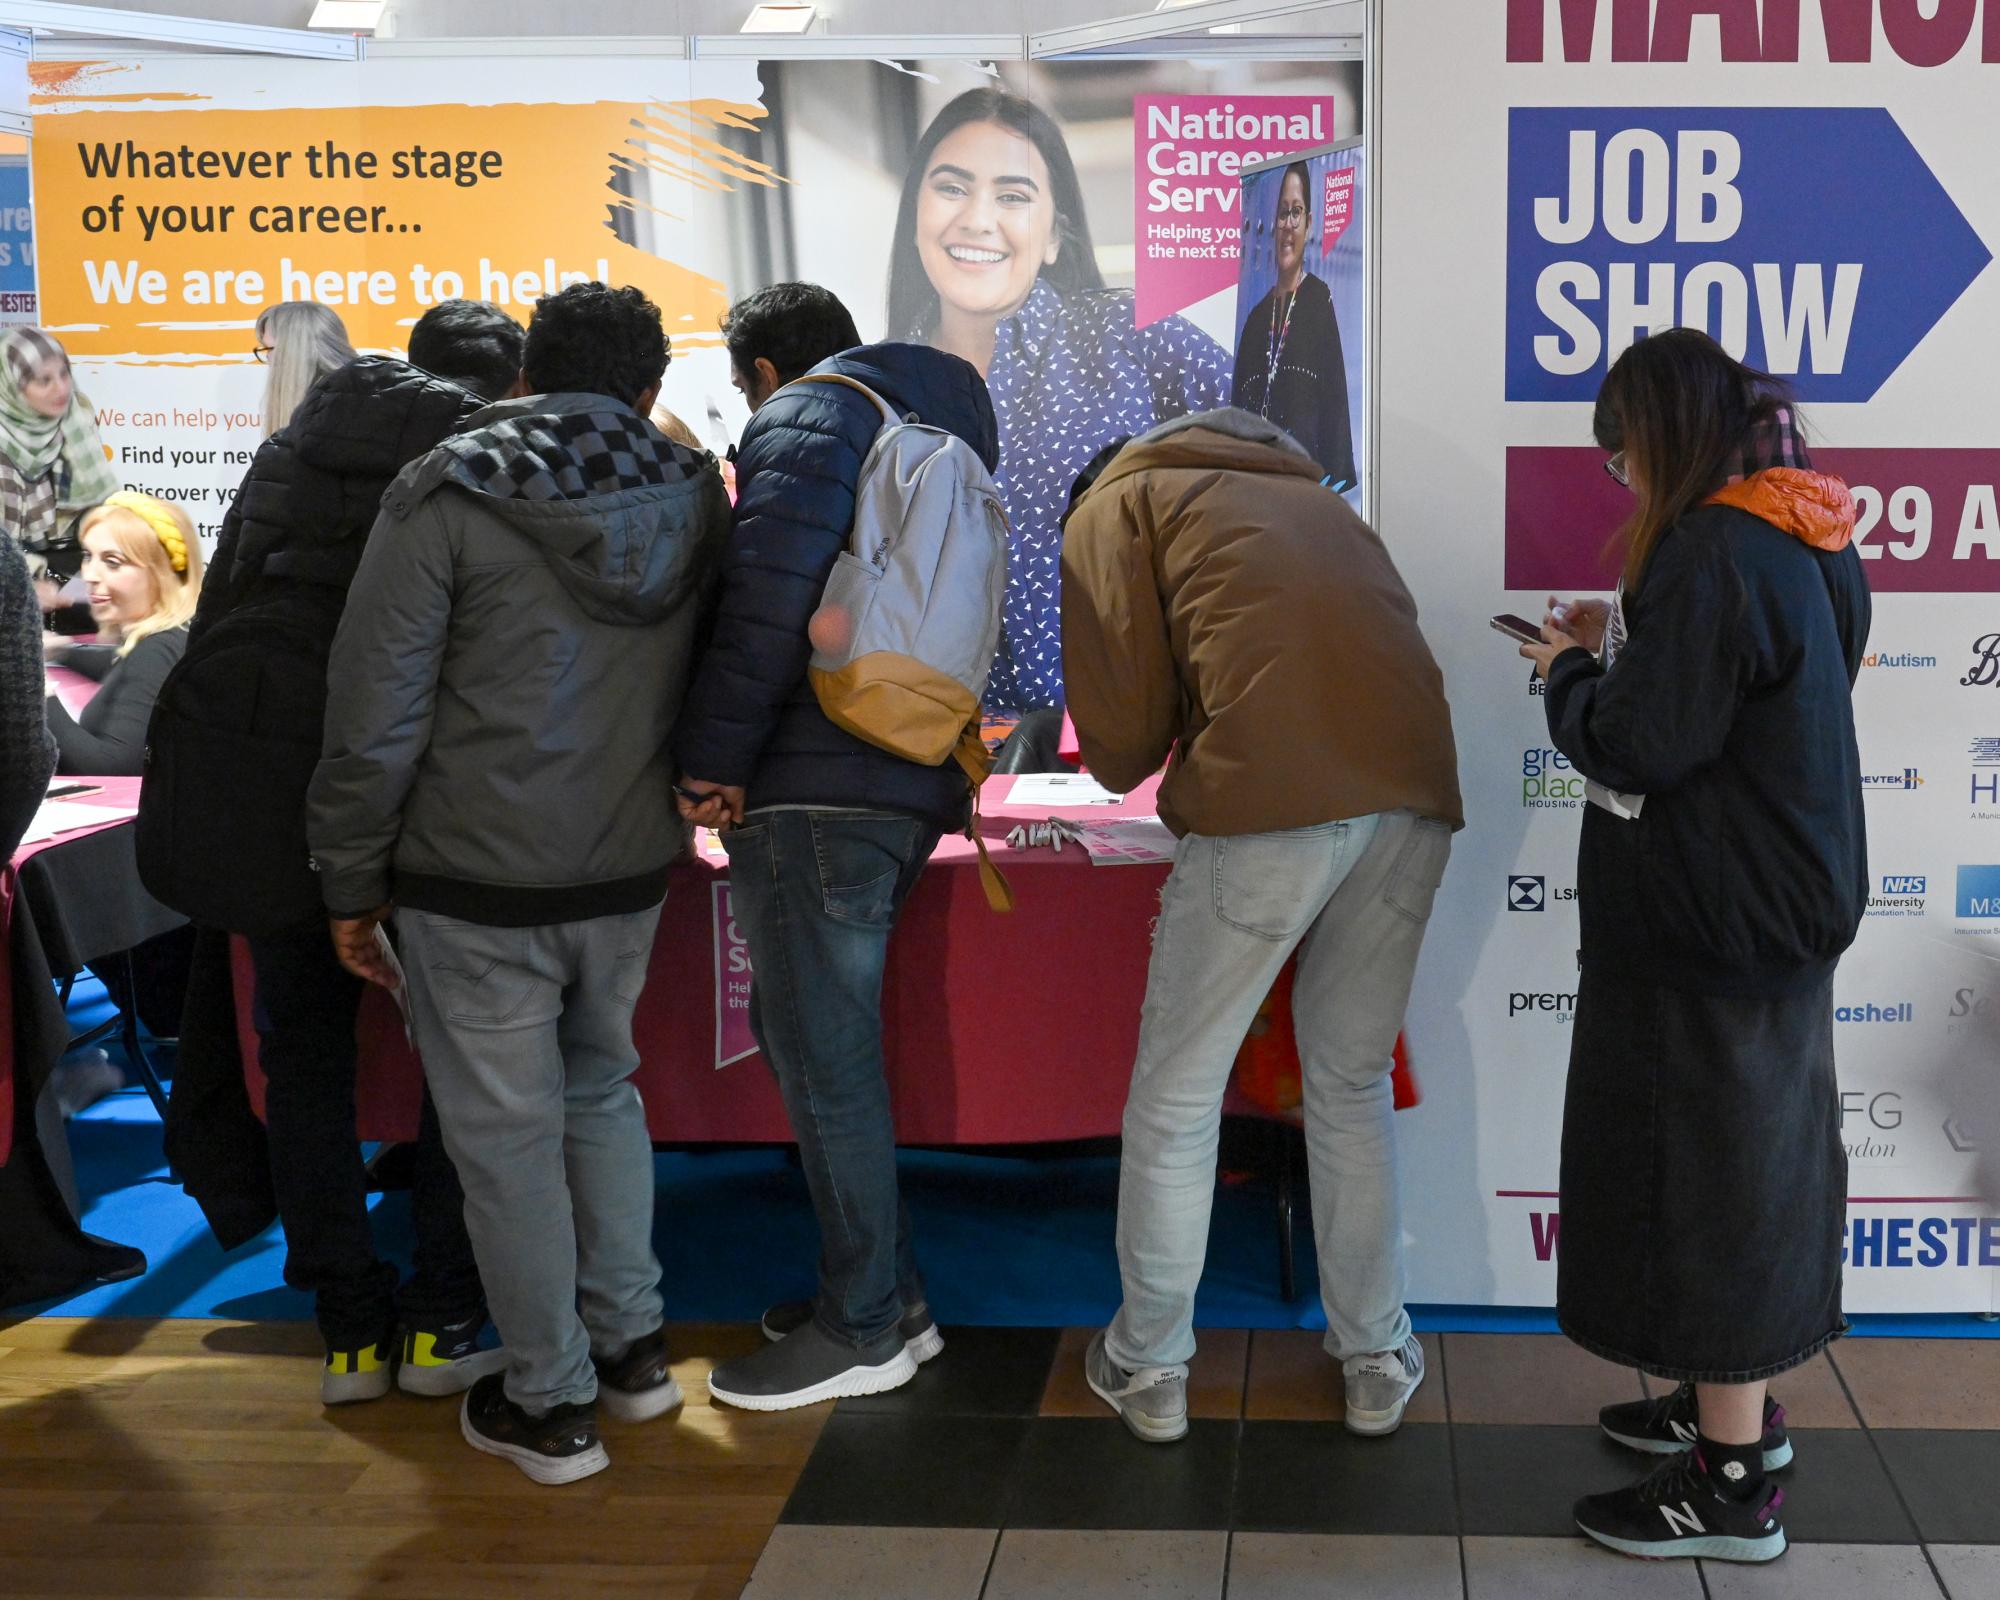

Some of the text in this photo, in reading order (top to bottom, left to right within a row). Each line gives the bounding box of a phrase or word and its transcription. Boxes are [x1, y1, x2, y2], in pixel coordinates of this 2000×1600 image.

[1147, 104, 1325, 140] National
[78, 140, 503, 188] Whatever the stage
[1147, 142, 1297, 176] Caree
[1147, 179, 1241, 213] Serv
[1534, 128, 1743, 245] JOB
[82, 195, 422, 241] of your career...
[1147, 224, 1212, 242] Helping
[1147, 243, 1175, 258] the
[1180, 244, 1216, 258] next
[83, 259, 167, 304] We
[183, 269, 264, 304] are
[280, 258, 397, 304] here
[410, 264, 463, 304] to
[1533, 261, 1864, 376] SHOW
[95, 408, 261, 431] We can help you
[121, 446, 164, 464] Find
[170, 451, 216, 468] your
[1848, 485, 1933, 561] 29
[1523, 771, 1583, 808] plac
[1528, 800, 1576, 808] HOUSING
[1884, 877, 1924, 893] NHS
[1867, 896, 1925, 910] University
[1954, 927, 1992, 935] Insurance
[728, 996, 750, 1009] the
[1154, 1375, 1181, 1386] balance
[1358, 1369, 1388, 1378] balance
[1659, 1501, 1706, 1536] N
